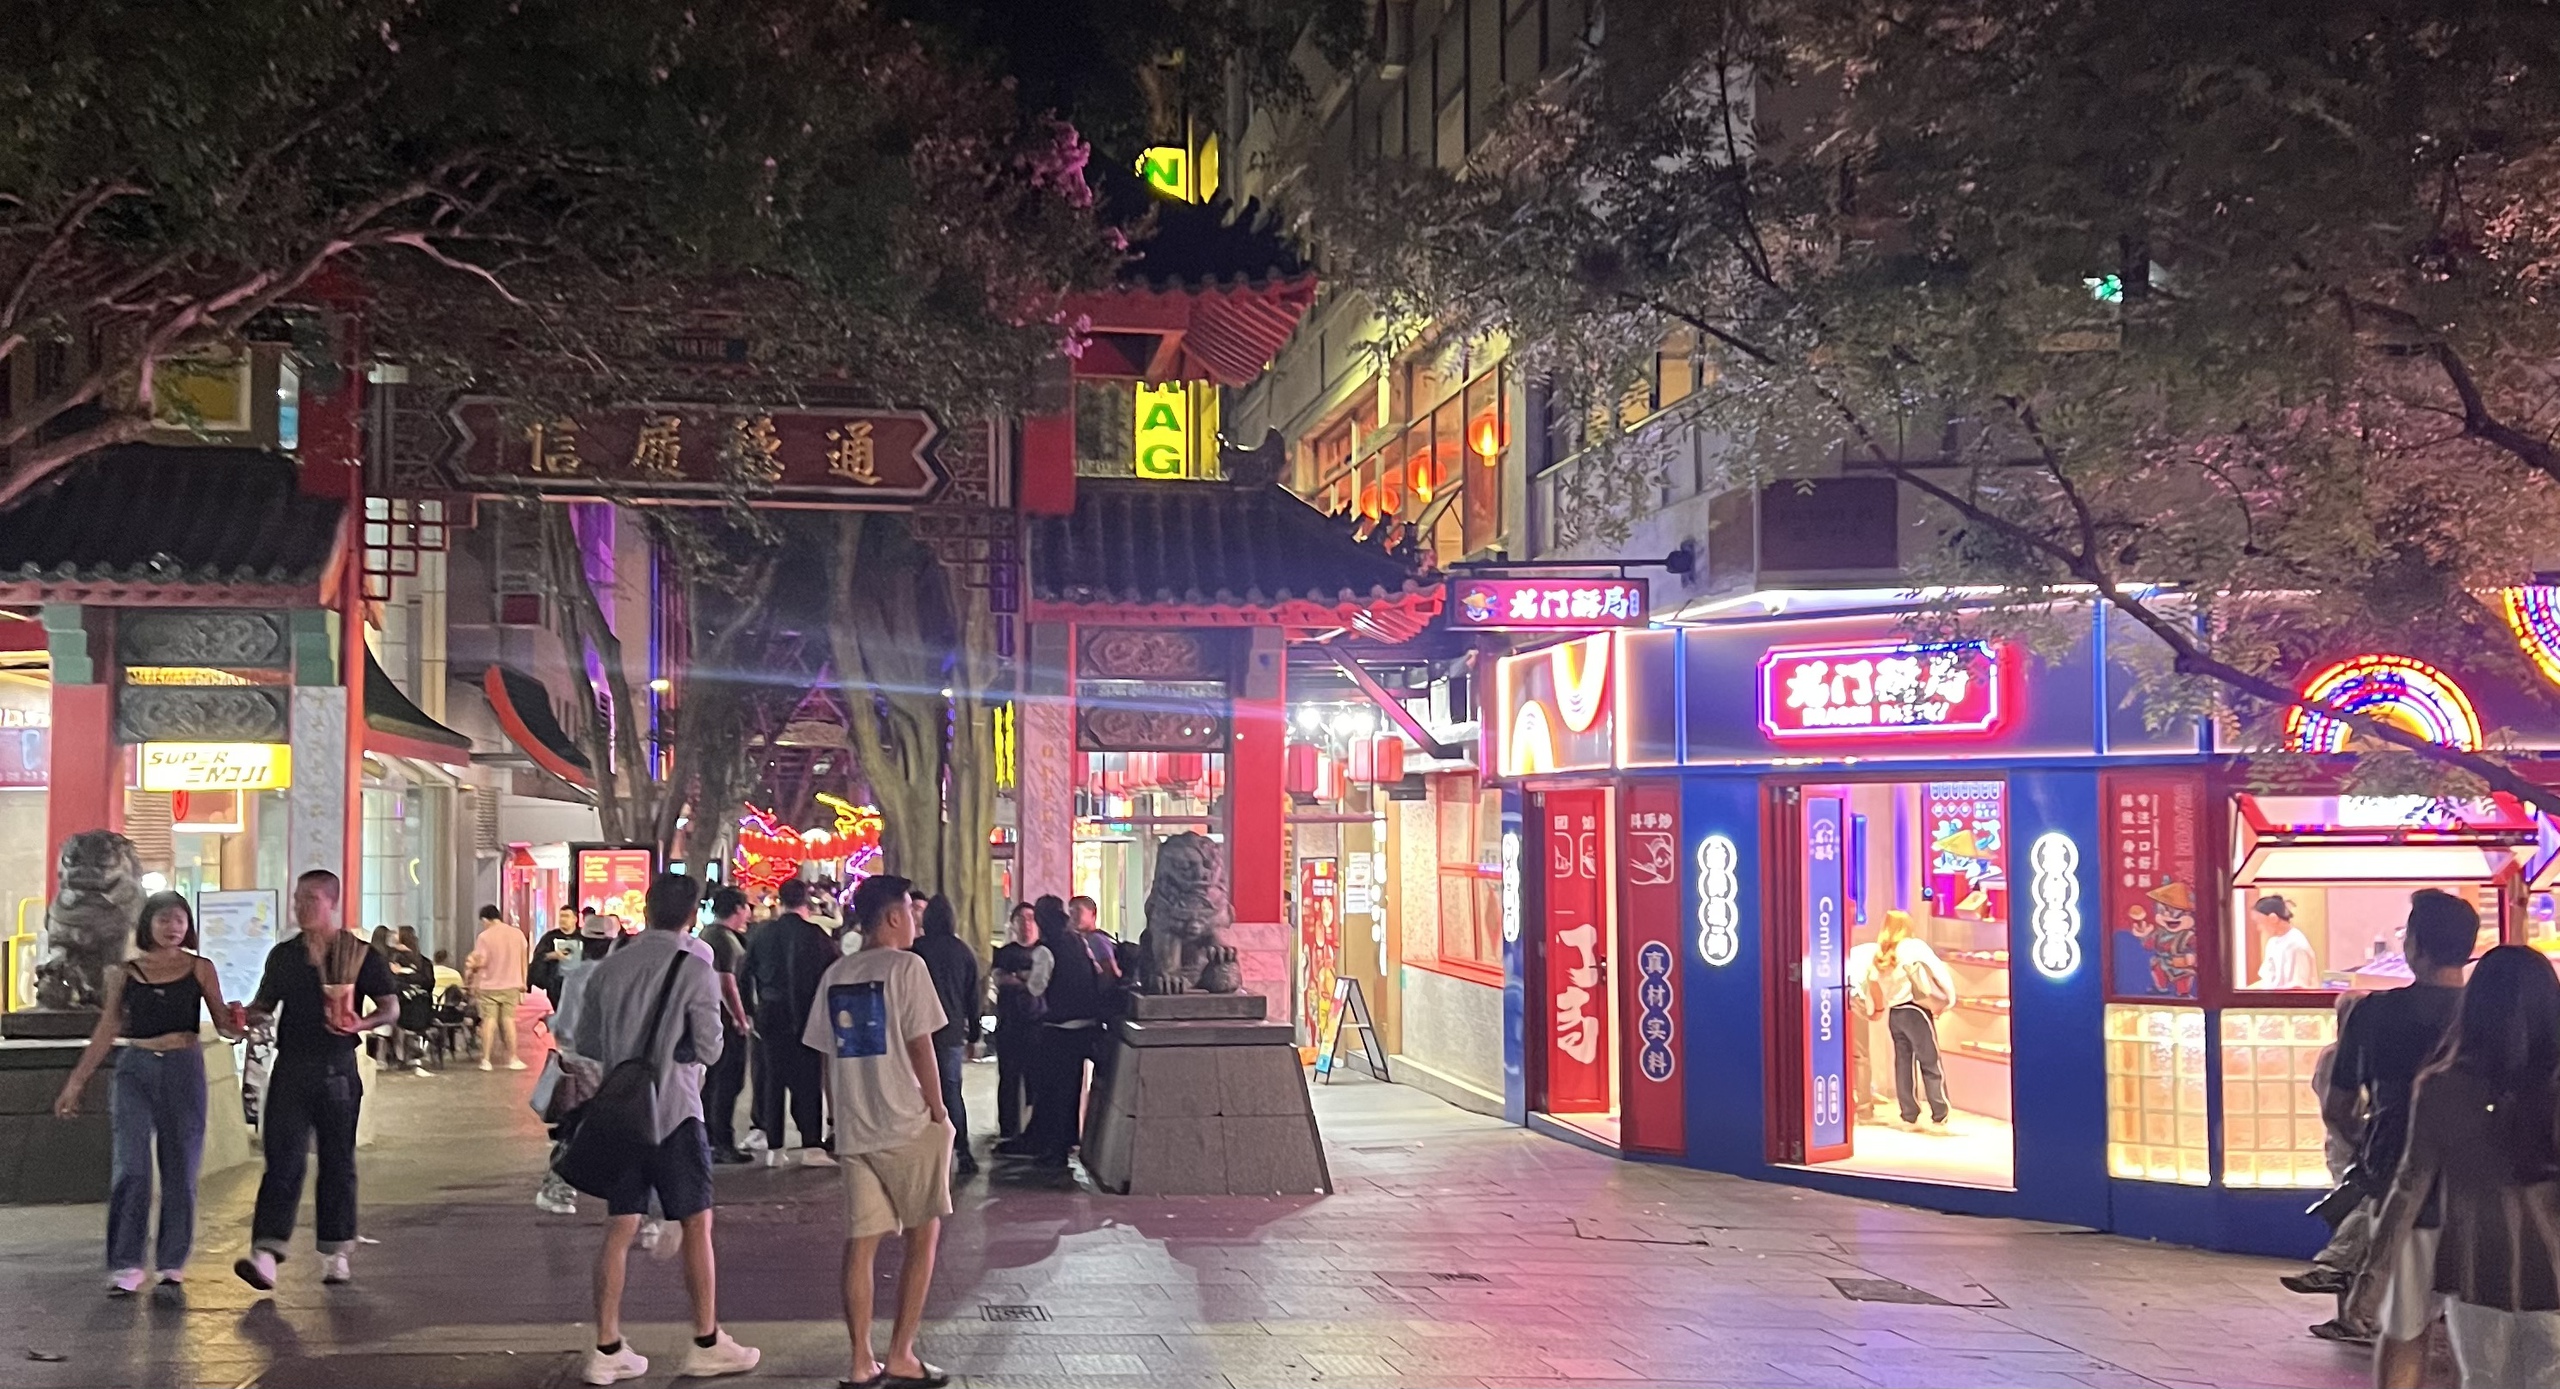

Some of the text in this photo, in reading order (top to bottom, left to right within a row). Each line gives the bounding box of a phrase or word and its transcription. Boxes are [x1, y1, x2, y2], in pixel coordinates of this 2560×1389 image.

[1645, 951, 1667, 1074] 真材实料
[1817, 896, 1833, 1040] Coming soon
